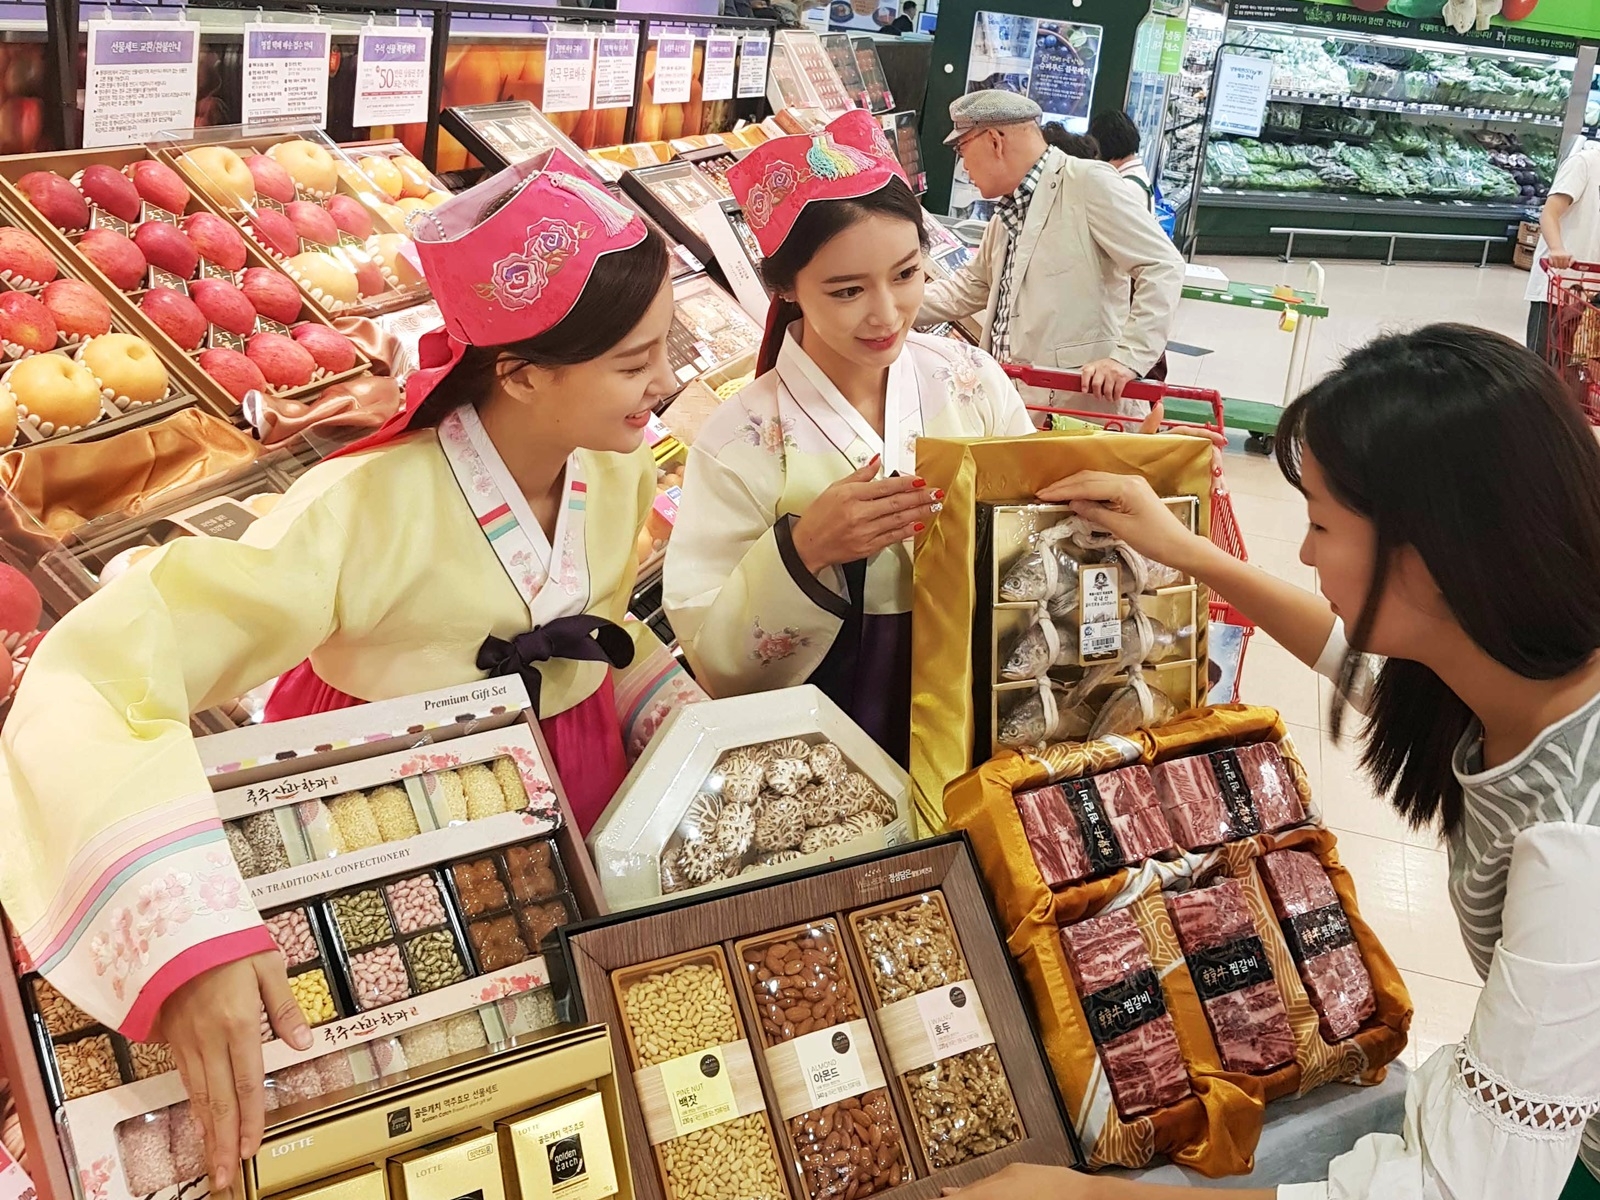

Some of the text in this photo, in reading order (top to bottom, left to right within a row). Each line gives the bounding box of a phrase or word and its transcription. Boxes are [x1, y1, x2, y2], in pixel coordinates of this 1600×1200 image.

[111, 41, 138, 54] 선물세트
[379, 68, 394, 88] 50
[424, 685, 507, 711] Premium Gift Set
[1221, 759, 1240, 793] 찜갈비
[1078, 789, 1099, 824] 찜갈비
[266, 868, 333, 894] TRADITIONAL
[334, 847, 411, 875] CONFECTIONERY
[1202, 956, 1259, 987] 韓牛 찜갈비
[1098, 990, 1152, 1029] 韓牛 찜갈비
[931, 1012, 955, 1025] WALNUT
[934, 1021, 951, 1036] 호두
[811, 1059, 837, 1073] ALMOND
[813, 1067, 840, 1083] 아몬드
[675, 1083, 704, 1098] PINE NUT
[414, 1084, 499, 1119] 골든캐치 맥주효모 선물세트
[678, 1094, 698, 1108] 백잣
[518, 1124, 540, 1136] LOTTE
[538, 1121, 585, 1144] 골든캐치 맥주효모
[271, 1135, 314, 1158] LOTTE
[554, 1149, 577, 1165] golden
[555, 1157, 579, 1172] catch
[415, 1164, 443, 1178] LOTTE
